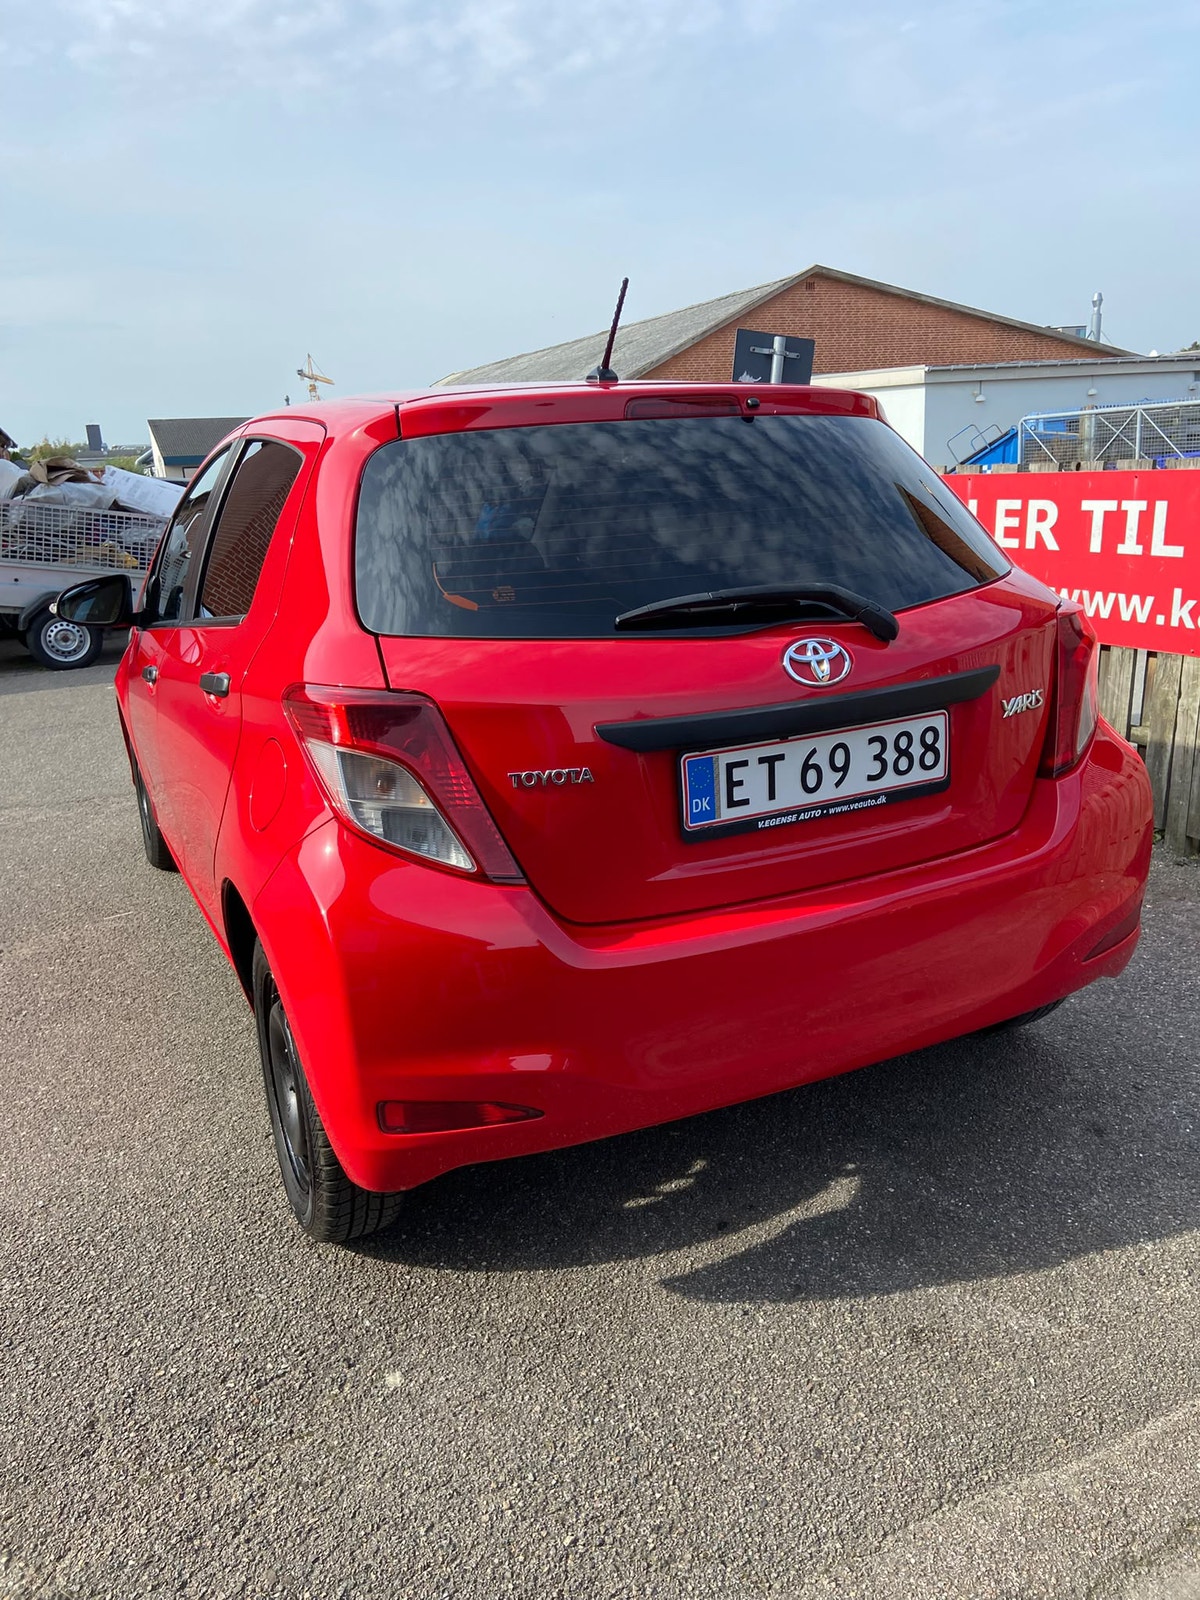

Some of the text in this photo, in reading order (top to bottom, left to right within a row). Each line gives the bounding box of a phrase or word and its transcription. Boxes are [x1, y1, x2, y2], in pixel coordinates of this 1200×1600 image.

[1081, 500, 1184, 558] TIL
[507, 767, 595, 789] TOYOTA
[725, 725, 942, 809] ET 69 388
[692, 797, 711, 813] DK
[757, 795, 887, 829] V.EGENSE AUTO www.veauto.dk
